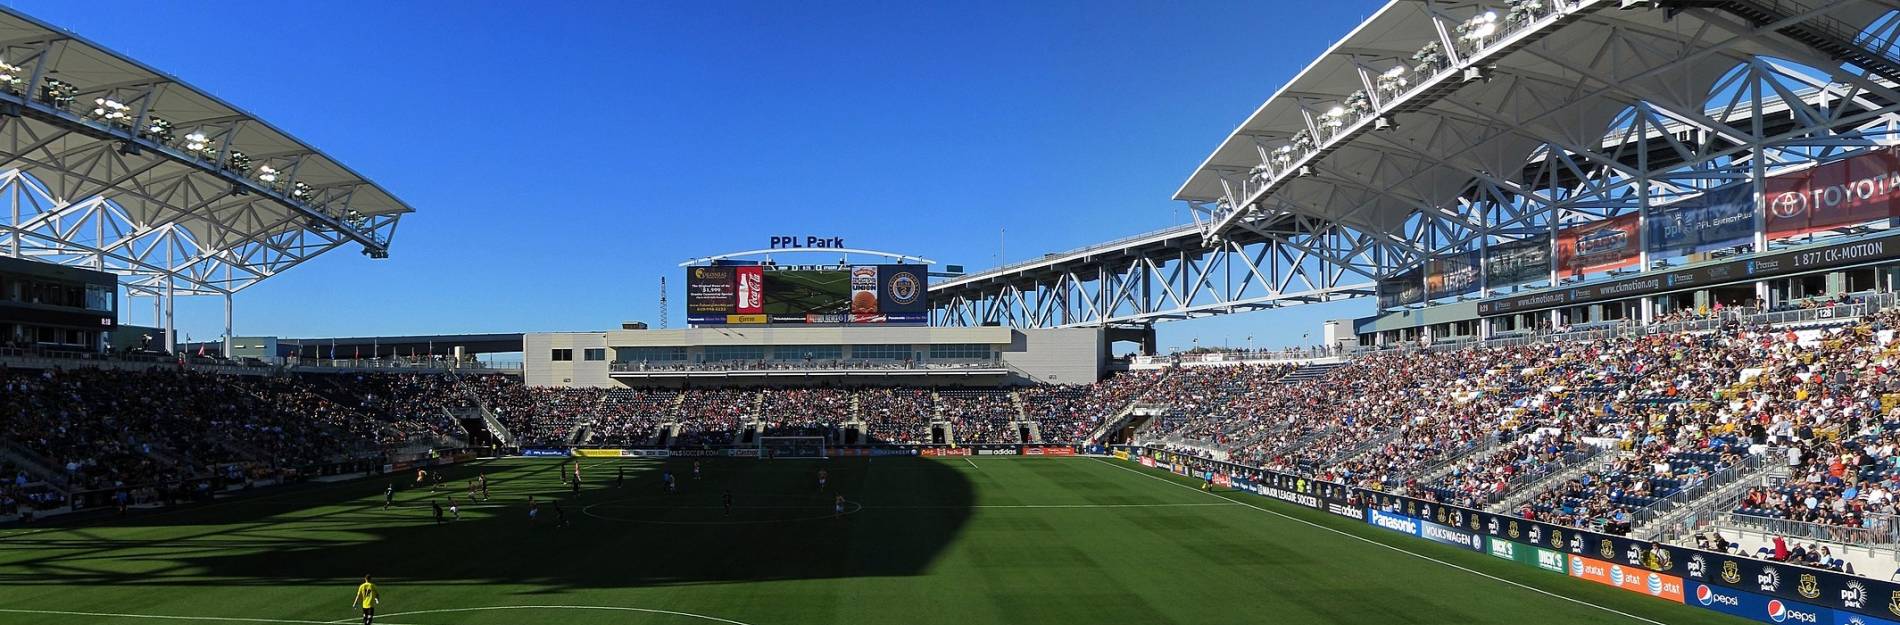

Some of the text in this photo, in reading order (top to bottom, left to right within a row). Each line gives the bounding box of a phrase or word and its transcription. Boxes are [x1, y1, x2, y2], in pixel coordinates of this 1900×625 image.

[1810, 170, 1900, 209] TOYOTA
[770, 236, 844, 248] PPL Park
[1793, 241, 1883, 266] 1 877 CK-MOTION
[1600, 279, 1659, 295] www.ckmotion.org
[993, 448, 1017, 456] adidas
[1262, 485, 1278, 498] MAJOR
[1278, 488, 1297, 503] LEAGUE
[1297, 492, 1317, 508] SOCCER
[1341, 504, 1363, 520] adidas
[1371, 509, 1417, 535] Panasonic
[1425, 525, 1471, 546] VOLKSWAGEN
[1584, 565, 1605, 577] at&t
[1688, 560, 1701, 573] ppl
[1625, 573, 1641, 586] at&t
[1758, 573, 1772, 585] ppl
[1663, 581, 1681, 594] at&t
[1760, 584, 1776, 592] park
[1713, 593, 1738, 606] pepsi
[1841, 588, 1858, 601] ppl
[1844, 600, 1862, 609] park
[1787, 609, 1817, 623] pepsi
